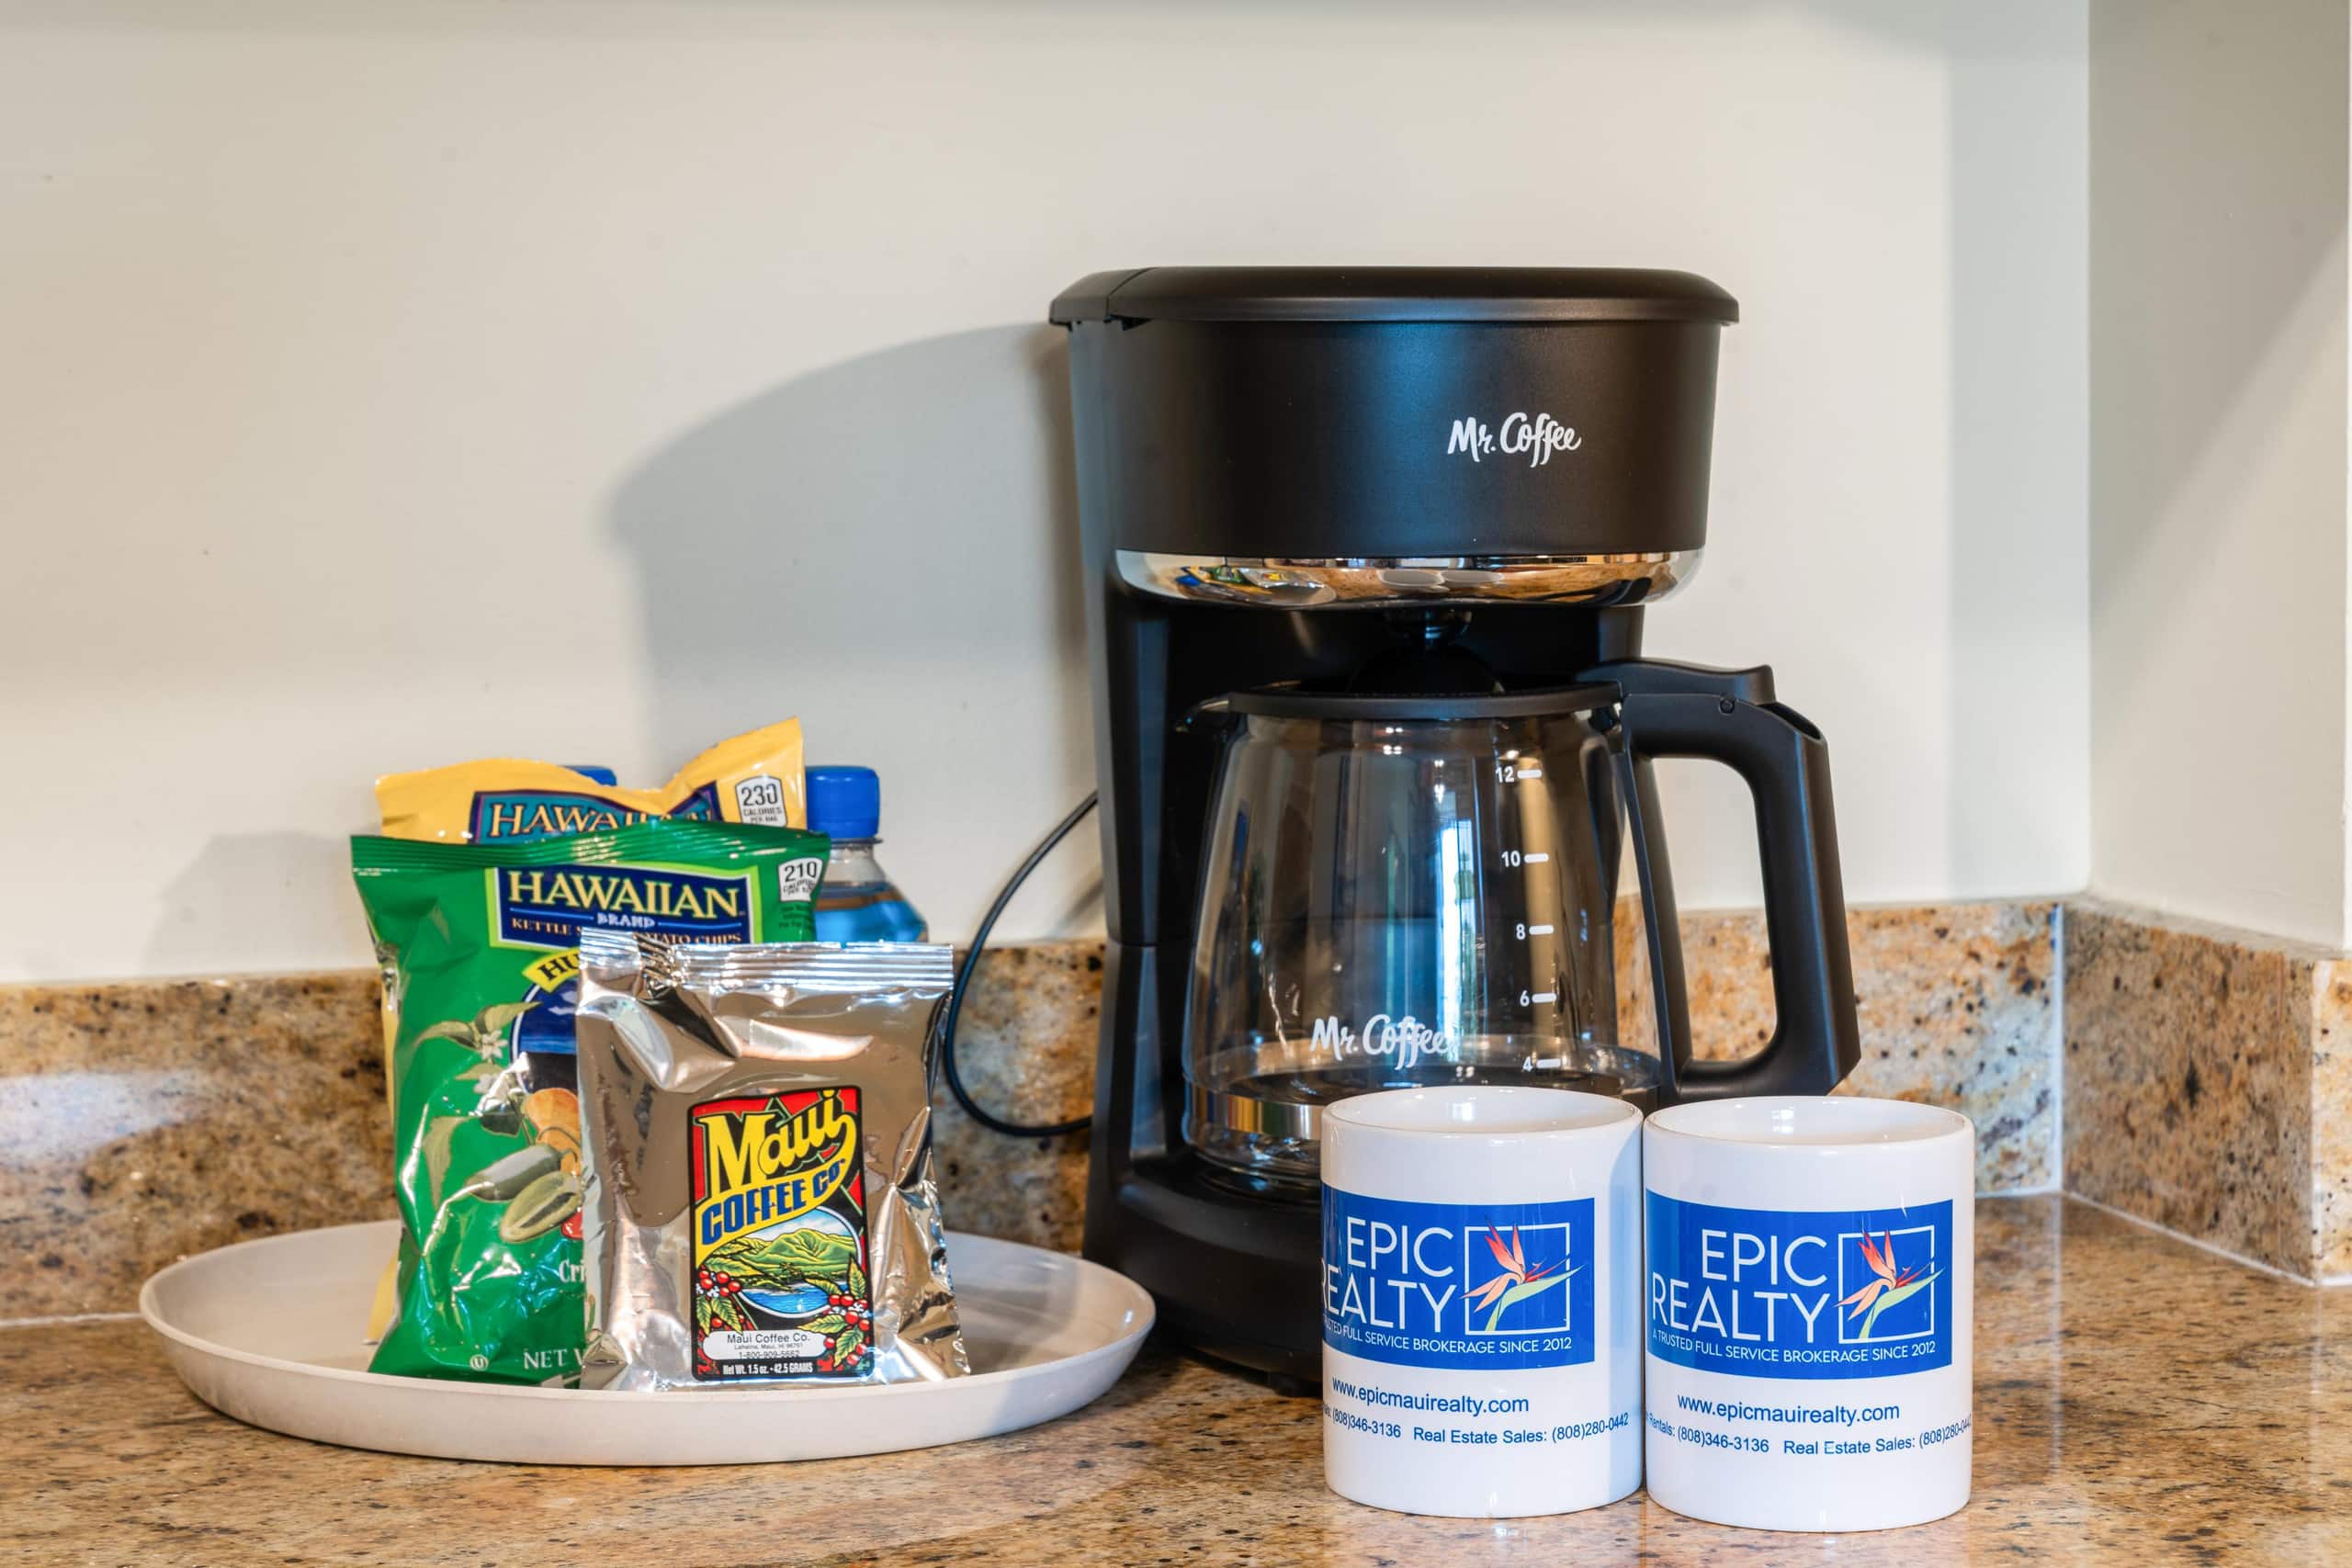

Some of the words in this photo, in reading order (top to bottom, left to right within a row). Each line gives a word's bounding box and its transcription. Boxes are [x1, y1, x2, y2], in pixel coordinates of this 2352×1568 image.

[1447, 416, 1497, 463] Mr.
[1499, 412, 1582, 468] Coffee
[1495, 765, 1515, 783] 12
[741, 783, 779, 807] 230
[784, 861, 818, 883] 210
[1500, 850, 1521, 867] 10
[508, 871, 740, 919] HAWAIIAN
[511, 917, 572, 936] KETTLE
[596, 912, 656, 929] BRAND
[1516, 923, 1526, 940] 8
[1520, 990, 1530, 1007] 6
[1308, 1015, 1359, 1062] Mr.
[1362, 1014, 1455, 1071] Coffee
[1521, 1055, 1533, 1073] 4
[698, 1089, 843, 1194] Maui
[701, 1179, 808, 1246] COFFEE
[1347, 1215, 1454, 1278] EPIC
[1702, 1228, 1828, 1287] EPIC
[1652, 1271, 1831, 1344] REALTY
[727, 1334, 752, 1344] Maui
[755, 1333, 790, 1344] Coffee
[793, 1333, 811, 1342] Co.
[1343, 1325, 1363, 1342] FULL
[1364, 1330, 1409, 1349] SERVICE
[1413, 1339, 1496, 1355] BROKERAGE
[1498, 1339, 1539, 1354] SINCE
[1543, 1337, 1573, 1352] 2012
[1657, 1329, 1693, 1351] TRUSTED
[1695, 1339, 1723, 1357] FULL
[1725, 1346, 1780, 1362] SERVICE
[1783, 1349, 1869, 1363] BROKERAGE
[1871, 1347, 1909, 1361] SINCE
[1911, 1340, 1937, 1357] 2012
[523, 1348, 568, 1371] NET
[789, 1362, 814, 1374] GRAMS
[1332, 1377, 1530, 1417] www.epicmauirealty.com
[1677, 1393, 1900, 1427] www.epicmauirealty.com
[1332, 1406, 1402, 1438] (808)346-3136
[1413, 1427, 1446, 1443] Real
[1451, 1428, 1498, 1445] Estate
[1502, 1429, 1547, 1445] Sales:
[1552, 1412, 1629, 1444] (808)280-0442
[1678, 1425, 1770, 1453] (808)346-3136
[1783, 1439, 1819, 1455] Real
[1824, 1440, 1871, 1455] Estate
[1875, 1437, 1916, 1453] Sales:
